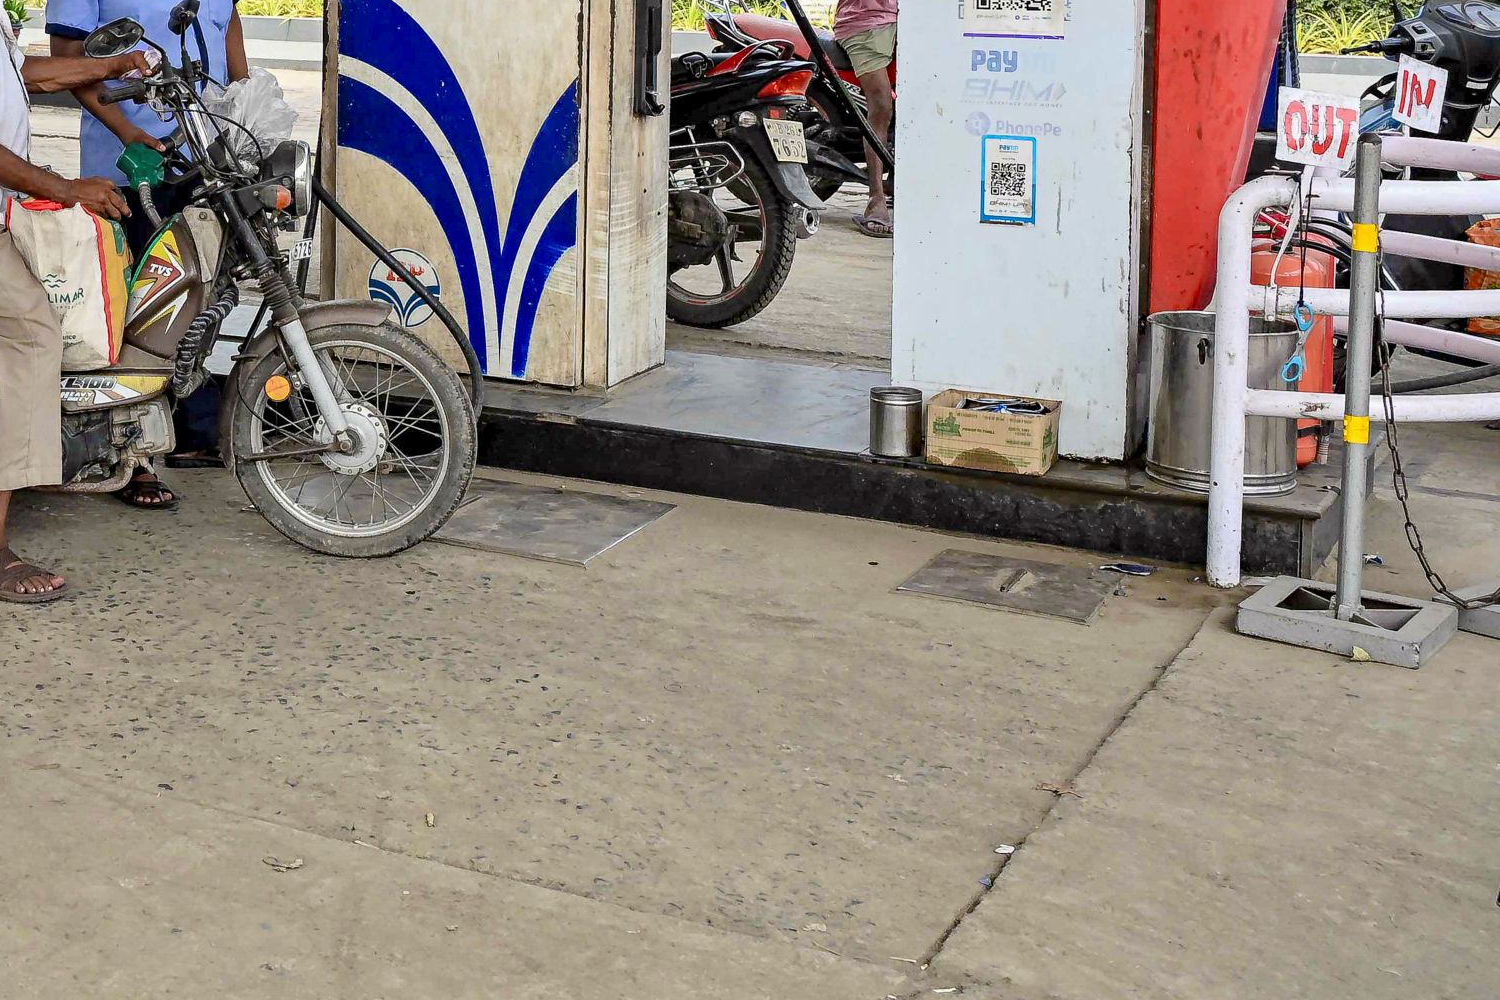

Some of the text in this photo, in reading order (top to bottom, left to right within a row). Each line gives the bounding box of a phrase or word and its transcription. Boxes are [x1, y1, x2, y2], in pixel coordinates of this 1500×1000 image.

[1398, 69, 1437, 118] IN
[995, 119, 1062, 137] PhonePe
[1284, 99, 1357, 159] OUT
[150, 264, 174, 277] TVS
